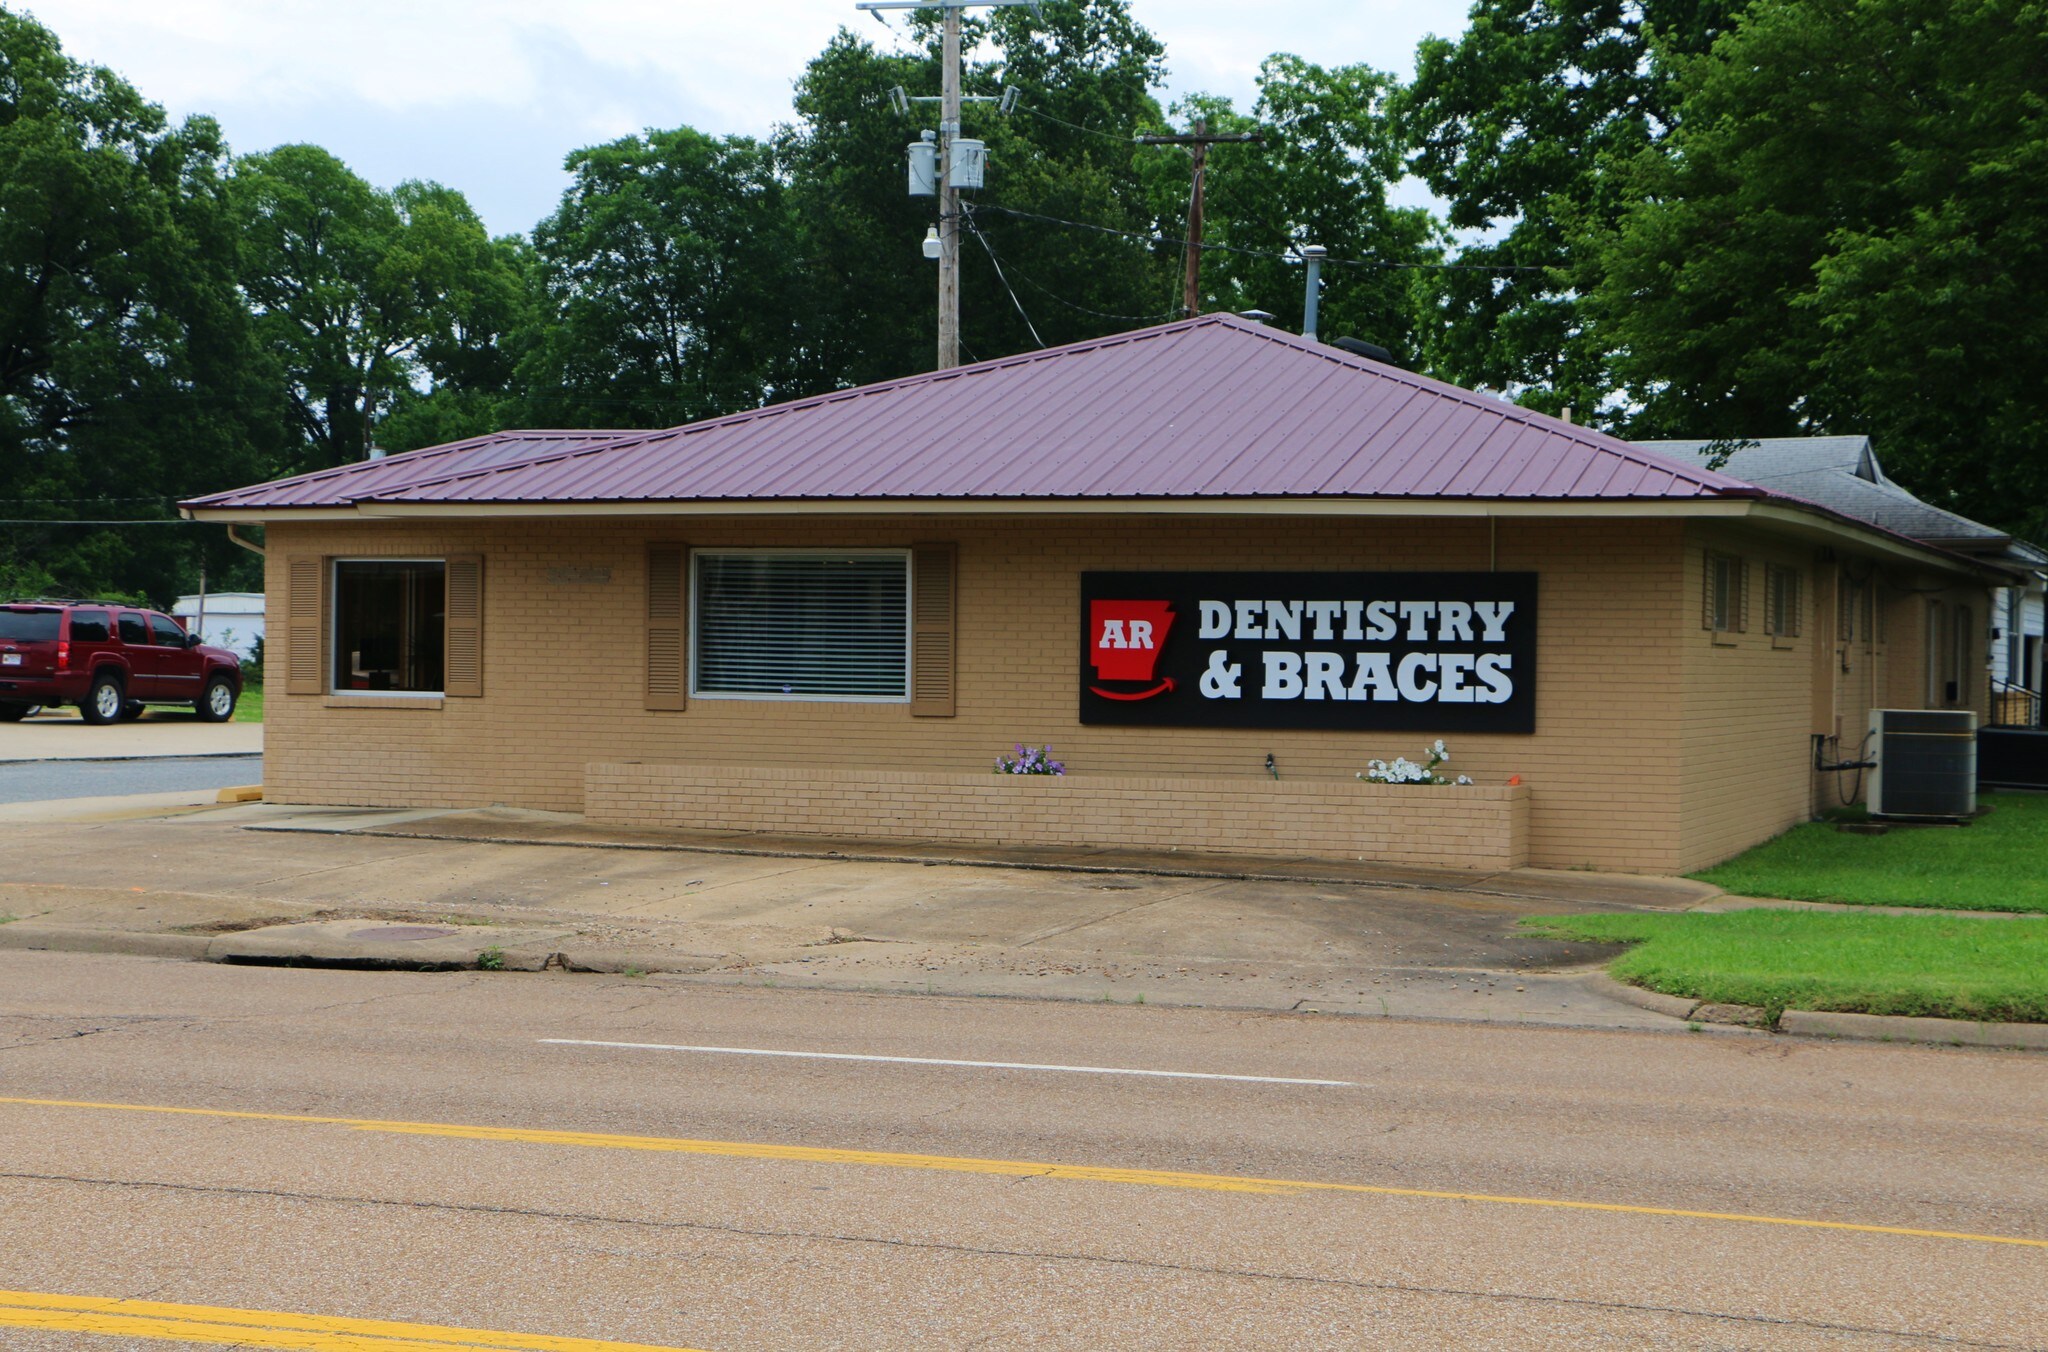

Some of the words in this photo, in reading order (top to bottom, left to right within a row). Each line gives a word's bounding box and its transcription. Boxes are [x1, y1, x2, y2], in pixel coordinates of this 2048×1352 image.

[1098, 619, 1154, 649] AR
[1199, 600, 1515, 642] DENTISTRY
[1199, 649, 1242, 699] &
[1261, 651, 1514, 704] BRACES
